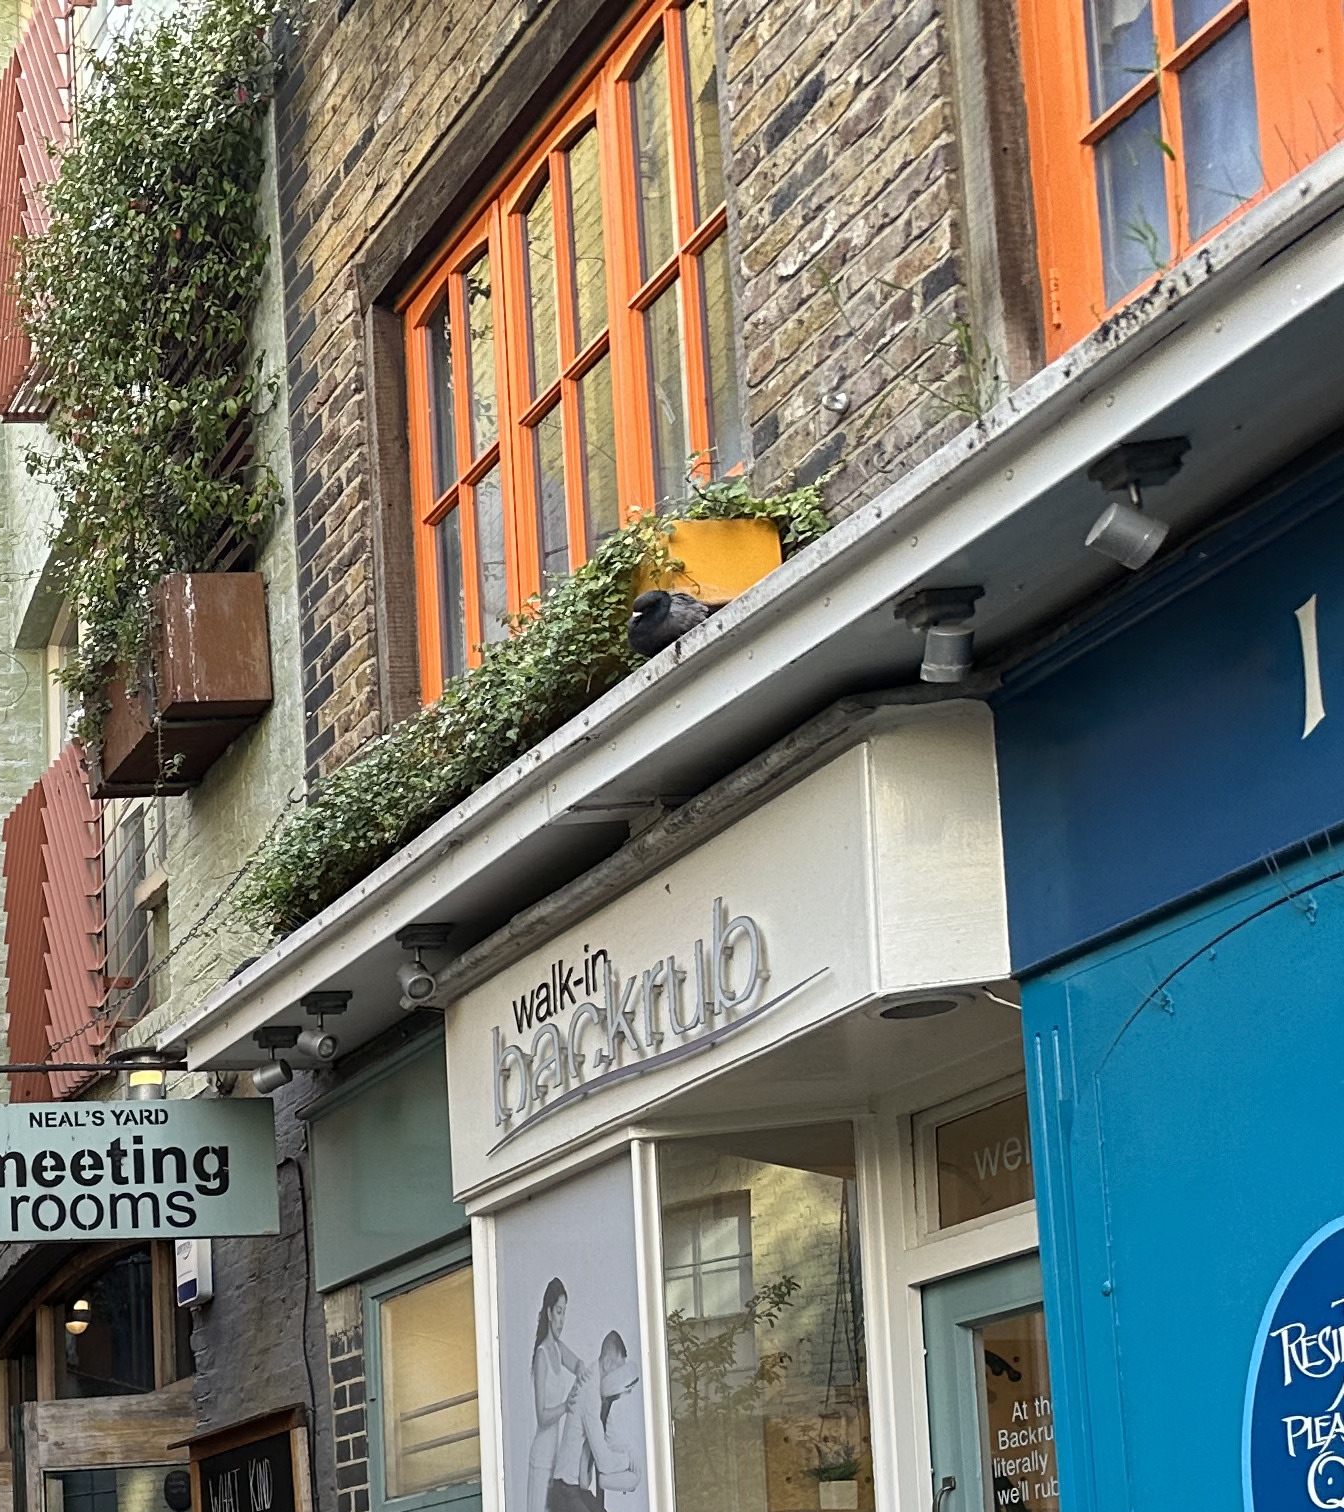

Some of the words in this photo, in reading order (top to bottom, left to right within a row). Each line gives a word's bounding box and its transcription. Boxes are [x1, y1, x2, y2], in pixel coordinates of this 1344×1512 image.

[512, 944, 608, 1034] walk-in
[492, 897, 759, 1127] backrub
[110, 1108, 169, 1126] YARD
[11, 1190, 197, 1232] rooms
[1012, 1401, 1028, 1422] At
[248, 1457, 273, 1512] KIND
[993, 1452, 1048, 1478] literally
